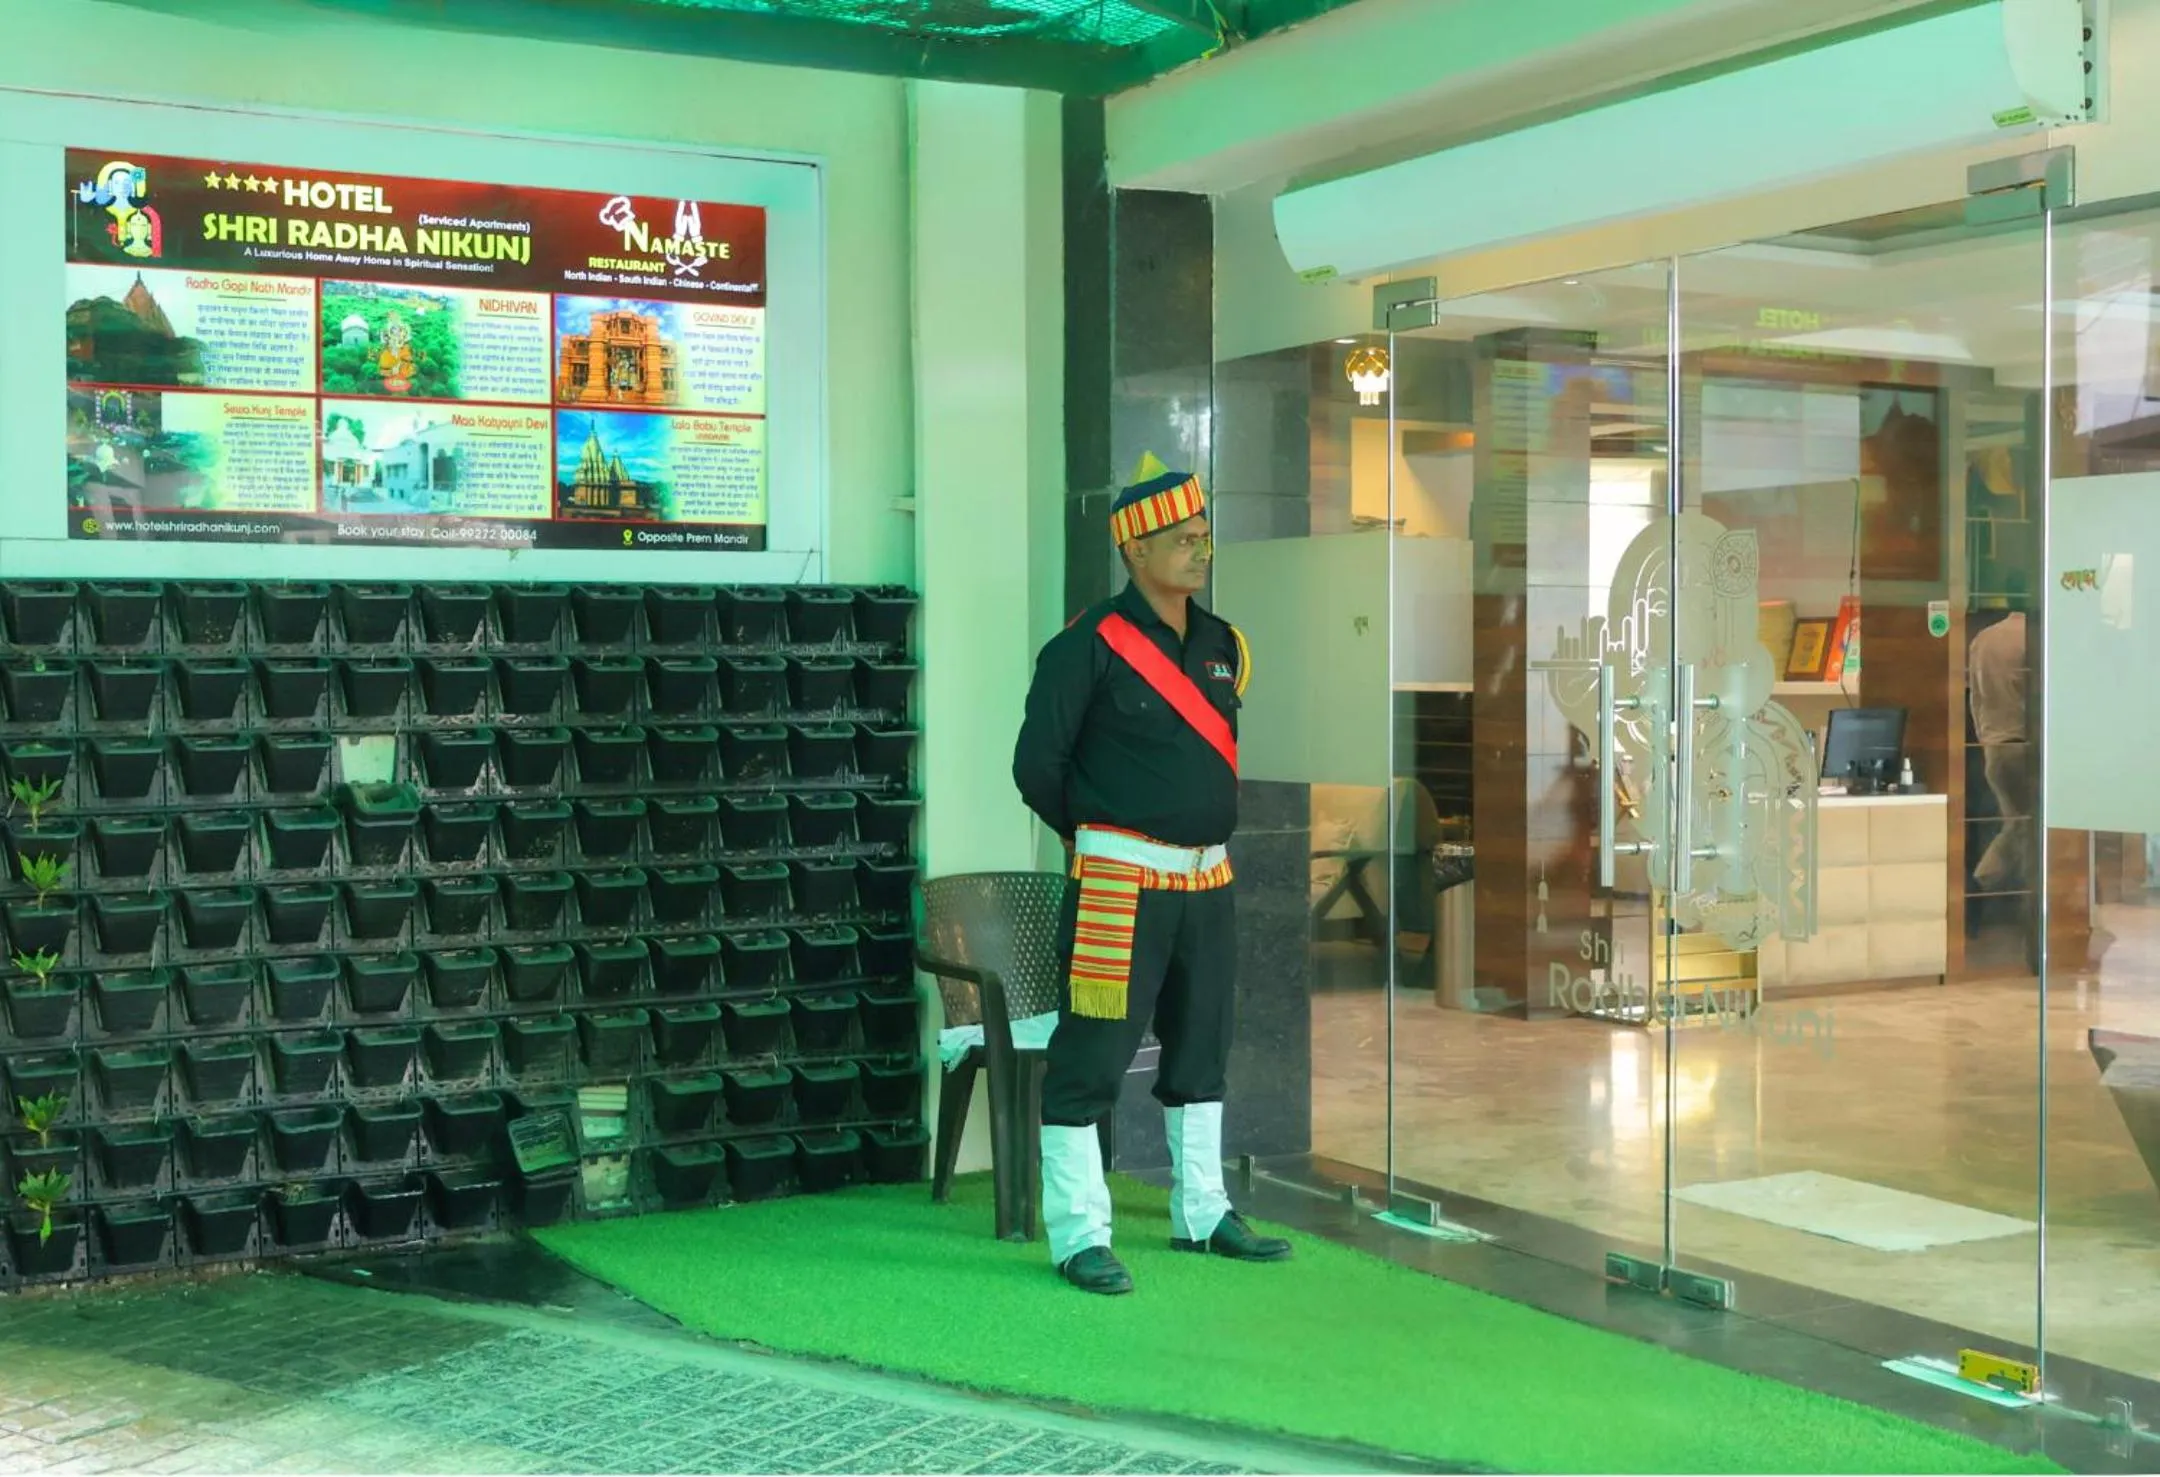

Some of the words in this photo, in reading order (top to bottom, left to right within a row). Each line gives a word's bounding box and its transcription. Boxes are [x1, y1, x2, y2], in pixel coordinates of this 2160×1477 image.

[284, 179, 393, 214] HOTEL
[418, 213, 468, 228] (Serviced
[469, 218, 531, 234] Apartments)
[203, 213, 278, 245] SHRI
[287, 219, 409, 254] RADHA
[416, 227, 532, 266] NIKUNJ
[623, 221, 731, 260] NAMASTE
[244, 246, 252, 257] A
[254, 247, 303, 260] Luxurious
[305, 251, 335, 263] Home
[335, 253, 362, 266] Away
[363, 255, 392, 267] Home
[404, 257, 444, 271] Spiritual
[446, 261, 495, 273] Sensation!
[588, 256, 667, 273] RESTAURANT
[185, 276, 219, 291] Radha
[221, 278, 248, 294] Gopi
[250, 281, 274, 294] Nath
[564, 270, 587, 281] North
[588, 271, 613, 283] Indian
[619, 273, 642, 285] South
[643, 275, 668, 287] Indian
[673, 278, 705, 289] Chinese
[479, 298, 538, 314] NIDHIVAN
[274, 404, 307, 418] Temple
[452, 414, 475, 427] Maa
[525, 416, 549, 431] Devi
[718, 420, 753, 435] Temple
[105, 519, 281, 536] www.hotelshriradhanikunj.com
[337, 523, 367, 537] Book
[370, 526, 399, 539] your
[500, 528, 538, 541] 00084
[637, 531, 684, 544] Opposite
[686, 533, 712, 544] Prem
[713, 533, 749, 545] Mandir
[1580, 929, 1625, 966] Shri
[1549, 961, 1687, 1026] Radha
[1703, 983, 1838, 1061] Nikunj
